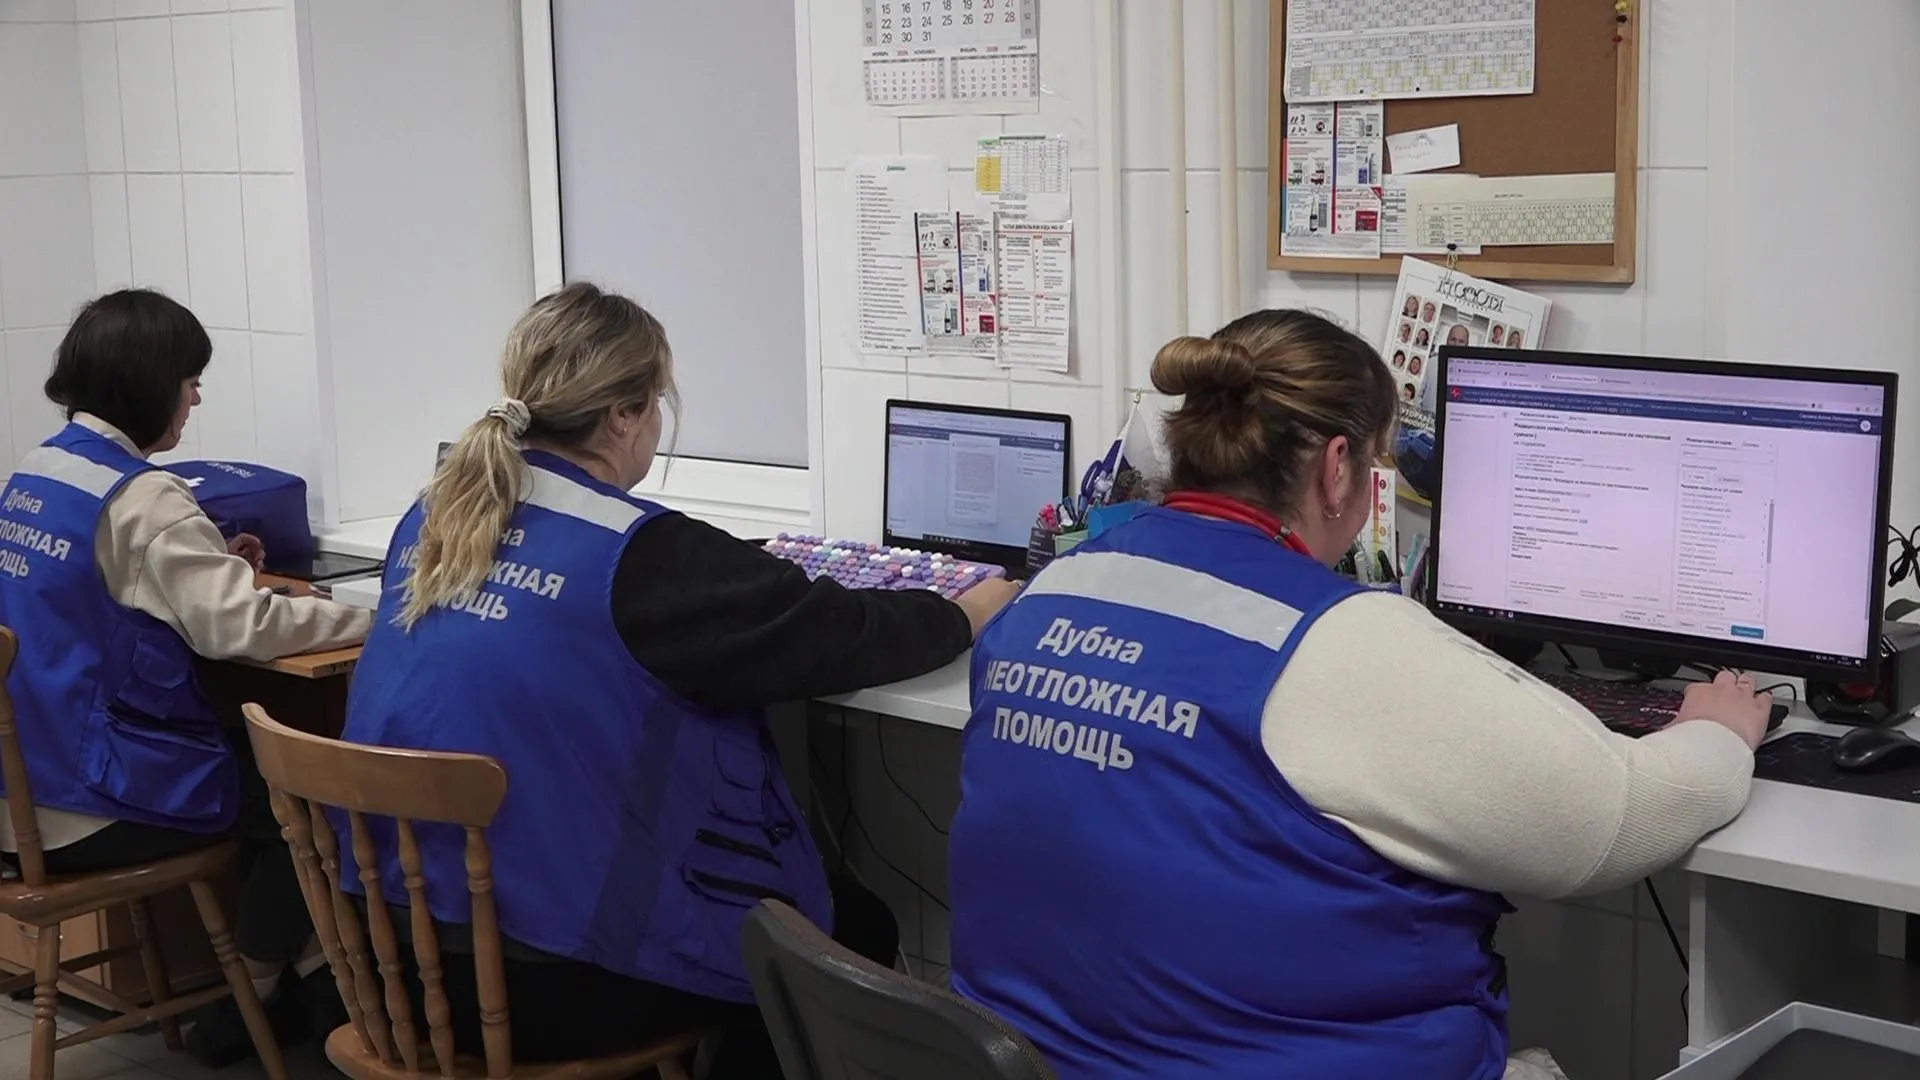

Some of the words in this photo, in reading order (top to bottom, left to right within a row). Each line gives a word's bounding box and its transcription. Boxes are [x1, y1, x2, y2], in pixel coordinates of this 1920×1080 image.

[881, 4, 891, 15] 15
[901, 3, 911, 14] 16
[922, 1, 931, 12] 17
[942, 0, 952, 11] 18
[963, 0, 972, 10] 19
[983, 0, 994, 9] 20
[881, 18, 892, 29] 22
[901, 17, 912, 28] 23
[921, 16, 932, 27] 24
[942, 15, 953, 26] 25
[962, 14, 974, 25] 26
[983, 12, 994, 24] 27
[1004, 11, 1016, 23] 28
[881, 32, 892, 44] 29
[901, 31, 912, 43] 30
[921, 31, 932, 42] 31
[3, 488, 43, 515] Дубна
[0, 519, 71, 562] ЛОЖНАЯ
[1036, 617, 1143, 665] Дубна
[984, 660, 1201, 739] НЕОТЛОЖНАЯ
[992, 707, 1134, 771] ПОМОЩЬ
